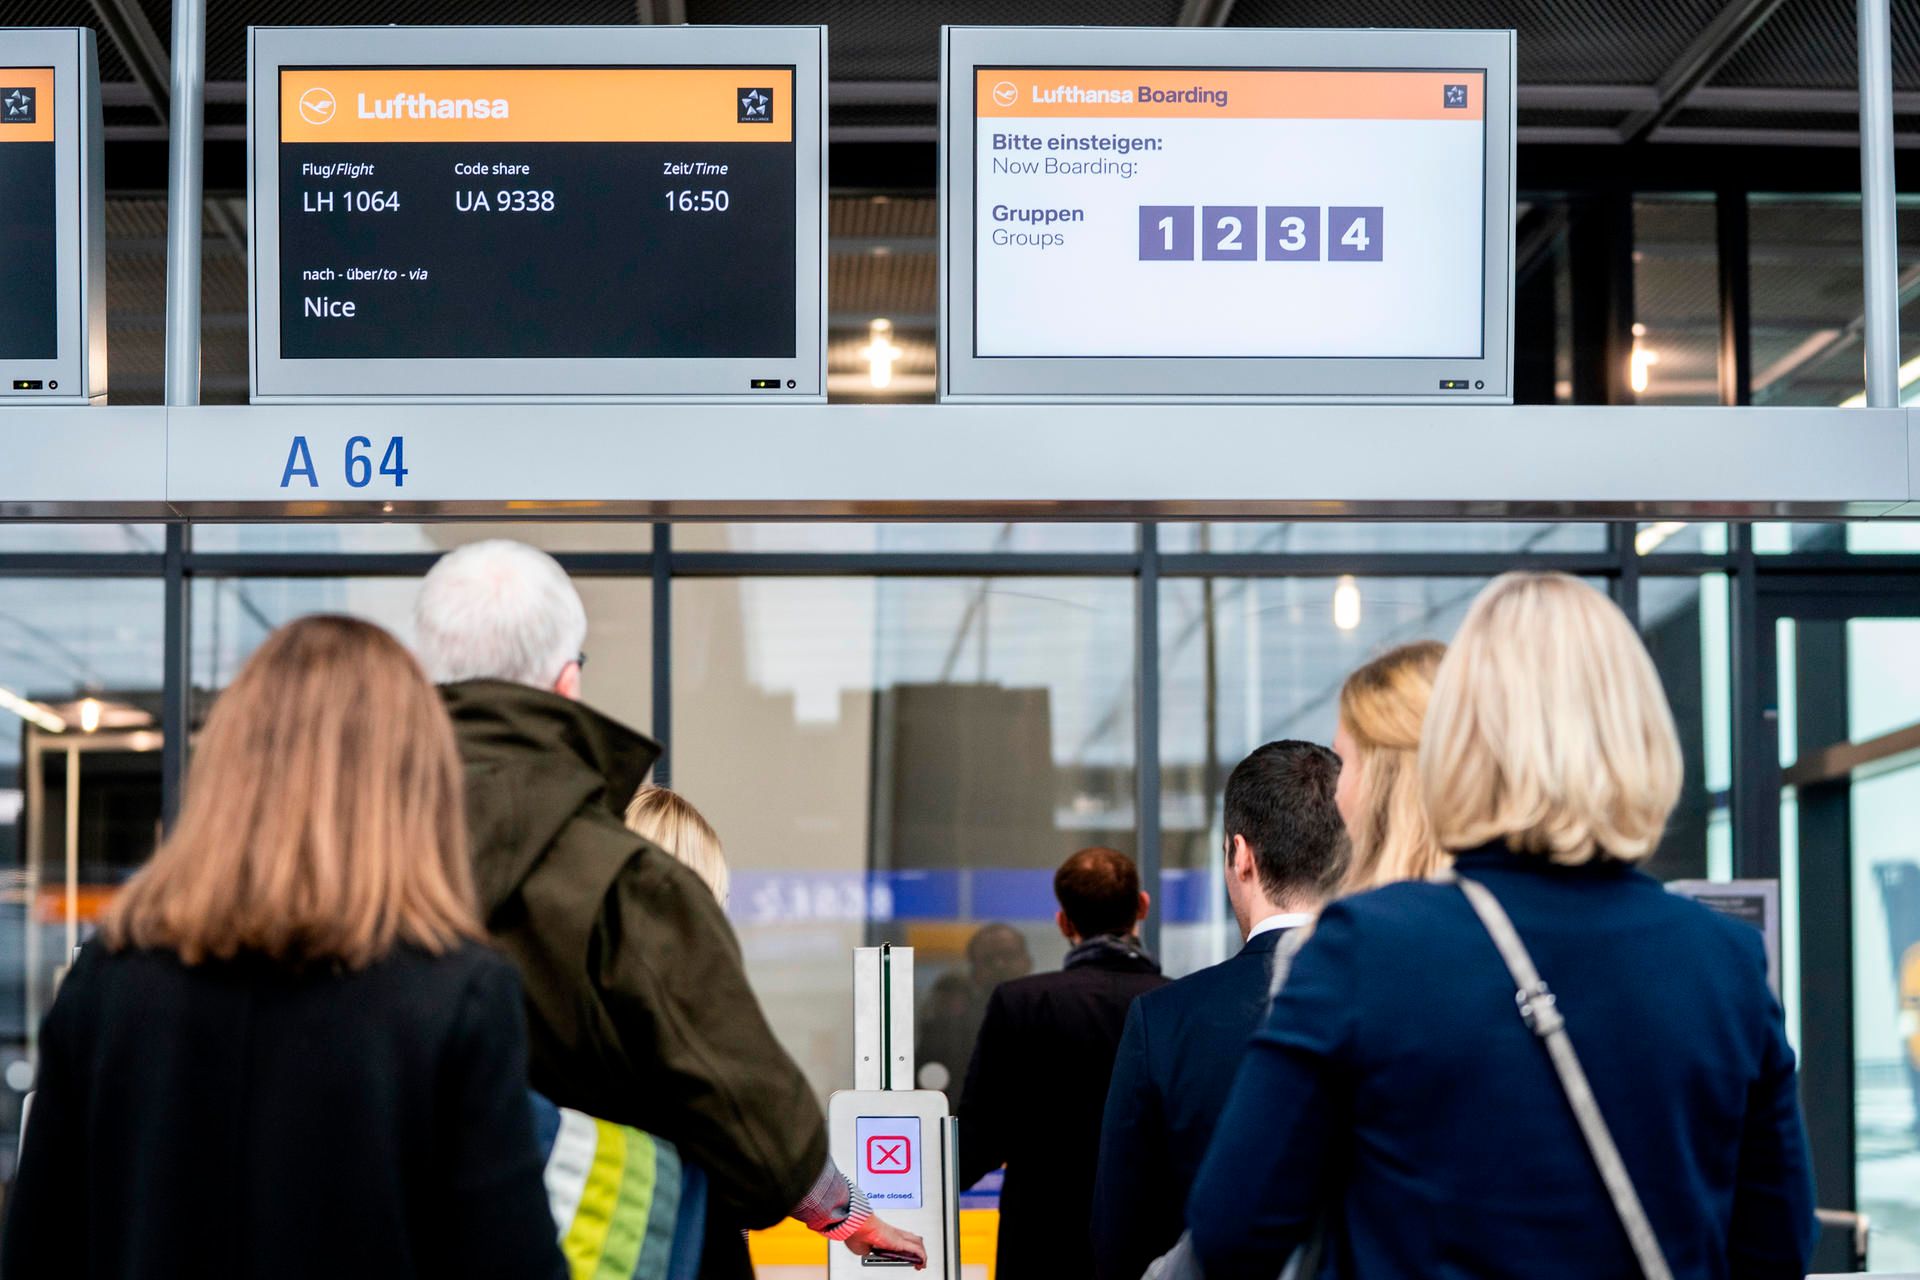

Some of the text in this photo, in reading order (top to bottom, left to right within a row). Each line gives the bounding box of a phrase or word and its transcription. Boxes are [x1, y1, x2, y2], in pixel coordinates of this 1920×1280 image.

[357, 93, 510, 120] Lufthansa
[1032, 85, 1228, 108] Lufthansa Boarding
[992, 133, 1163, 155] Bitte einsteigen:
[302, 162, 375, 179] Flug/Flight
[454, 162, 530, 175] Code share
[663, 161, 729, 176] Zeit/Time
[993, 157, 1138, 179] Now Boarding:
[303, 190, 401, 212] LH 1064
[455, 190, 555, 212] UA 9338
[665, 190, 730, 212] 16:50
[992, 204, 1084, 226] Gruppen
[992, 228, 1065, 250] Groups
[1158, 216, 1370, 252] 1 2 3 4
[303, 267, 335, 281] nach
[346, 267, 398, 281] über/to
[408, 267, 429, 281] via
[304, 296, 356, 318] Nice
[279, 435, 409, 488] A 64
[866, 1192, 915, 1200] Gate closed.
